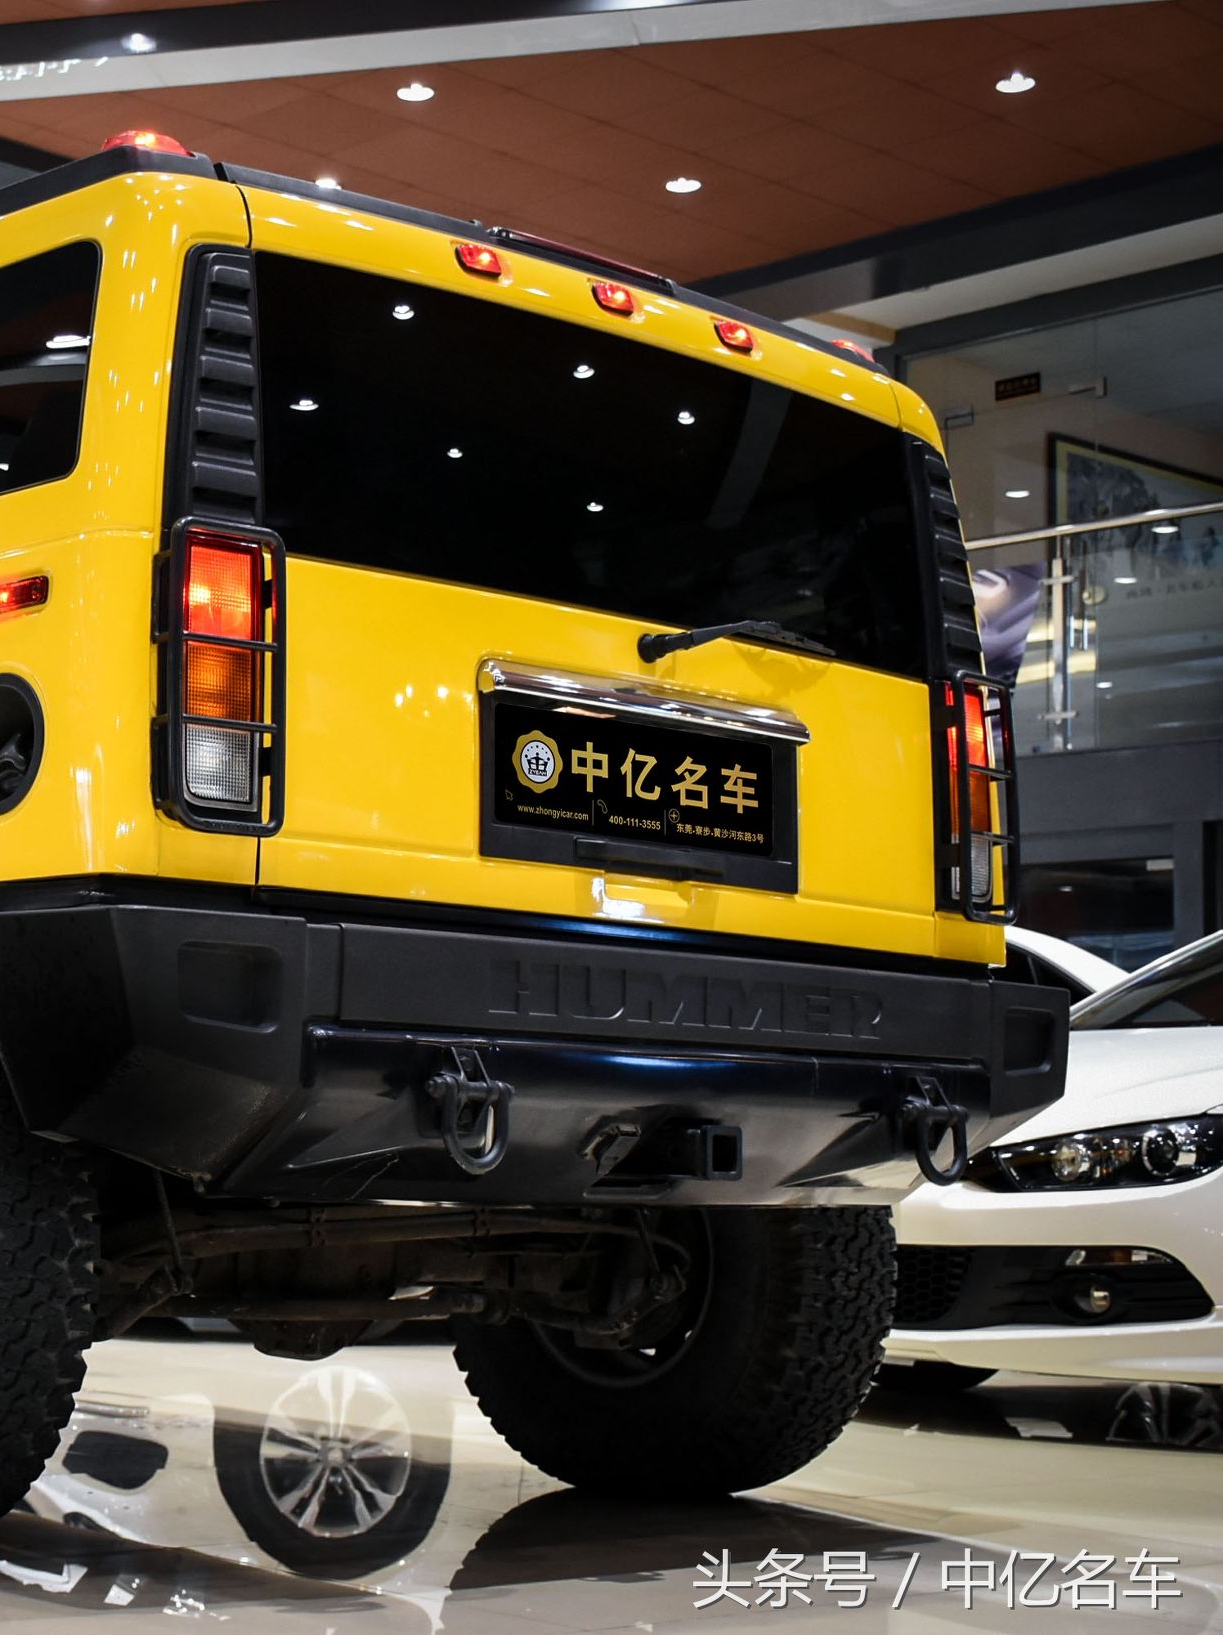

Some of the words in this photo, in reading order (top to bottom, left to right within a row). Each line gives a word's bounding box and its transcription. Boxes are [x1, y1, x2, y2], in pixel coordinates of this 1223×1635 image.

[571, 741, 759, 814] 中亿名车
[517, 803, 589, 821] www.zhongyicar.com
[608, 815, 661, 832] 400-111-3555
[488, 960, 882, 1040] HUMMER
